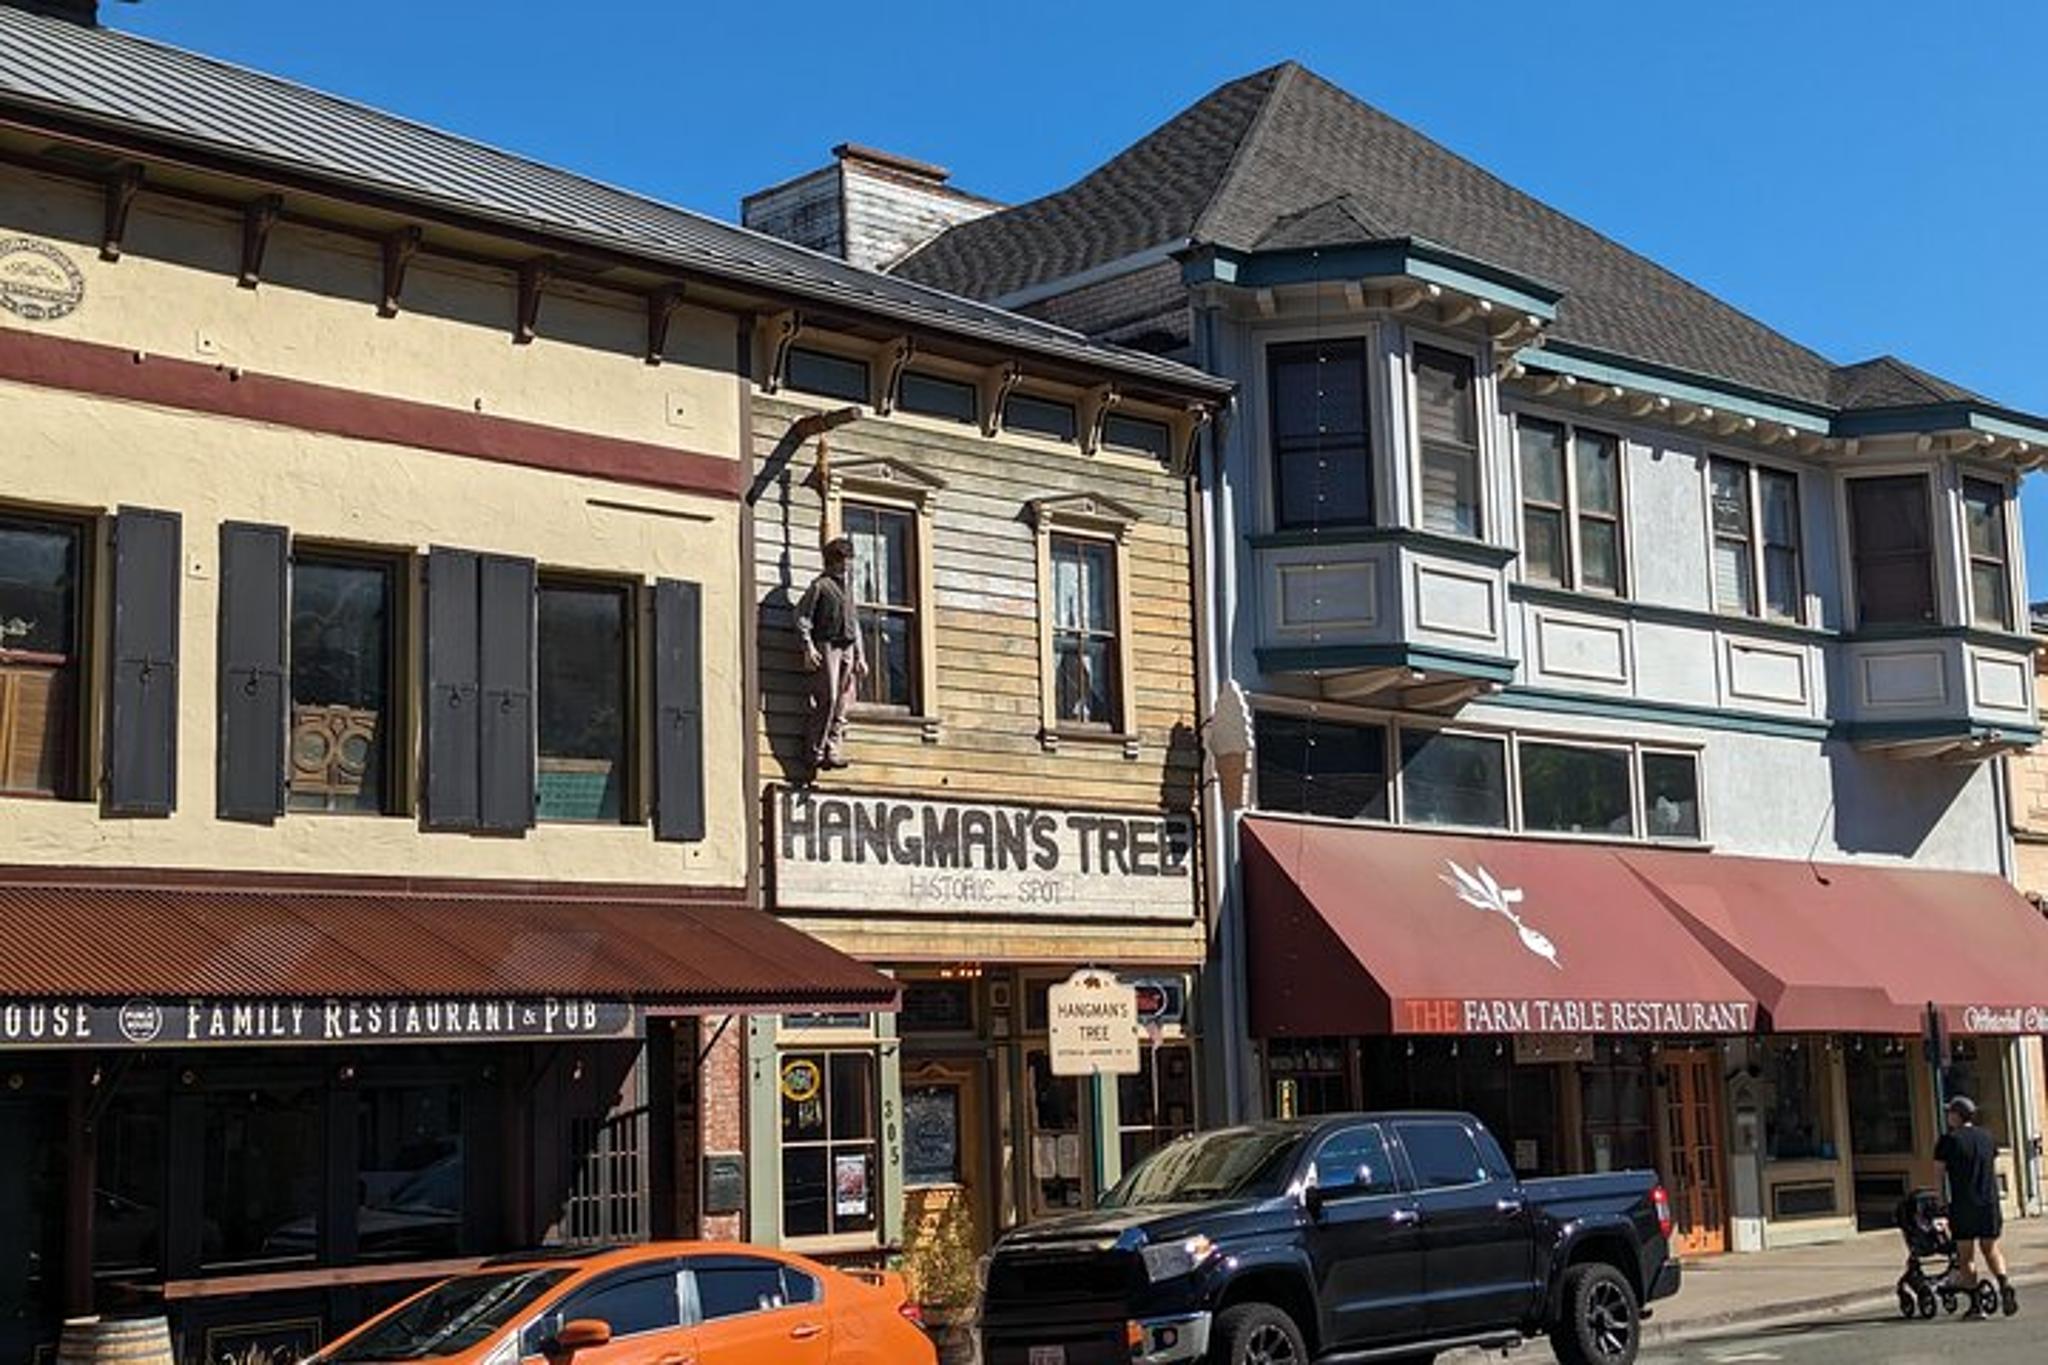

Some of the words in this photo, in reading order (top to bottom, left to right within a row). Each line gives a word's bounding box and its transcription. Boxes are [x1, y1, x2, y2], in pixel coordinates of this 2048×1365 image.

[782, 793, 1059, 871] HANGMAN'S
[1067, 816, 1188, 877] TREE
[1018, 878, 1061, 904] SPOT
[5, 1001, 91, 1038] OUSE
[187, 999, 304, 1039] FAMILY
[324, 999, 516, 1038] RESTAURANT
[545, 997, 597, 1033] PUB
[1058, 1002, 1128, 1018] HANGMAN'S
[1405, 1000, 1457, 1031] THE
[1463, 1000, 1532, 1031] FARM
[1534, 1000, 1605, 1031] TABLE
[1611, 1001, 1749, 1032] RESTAURANT
[1079, 1025, 1110, 1041] TREE
